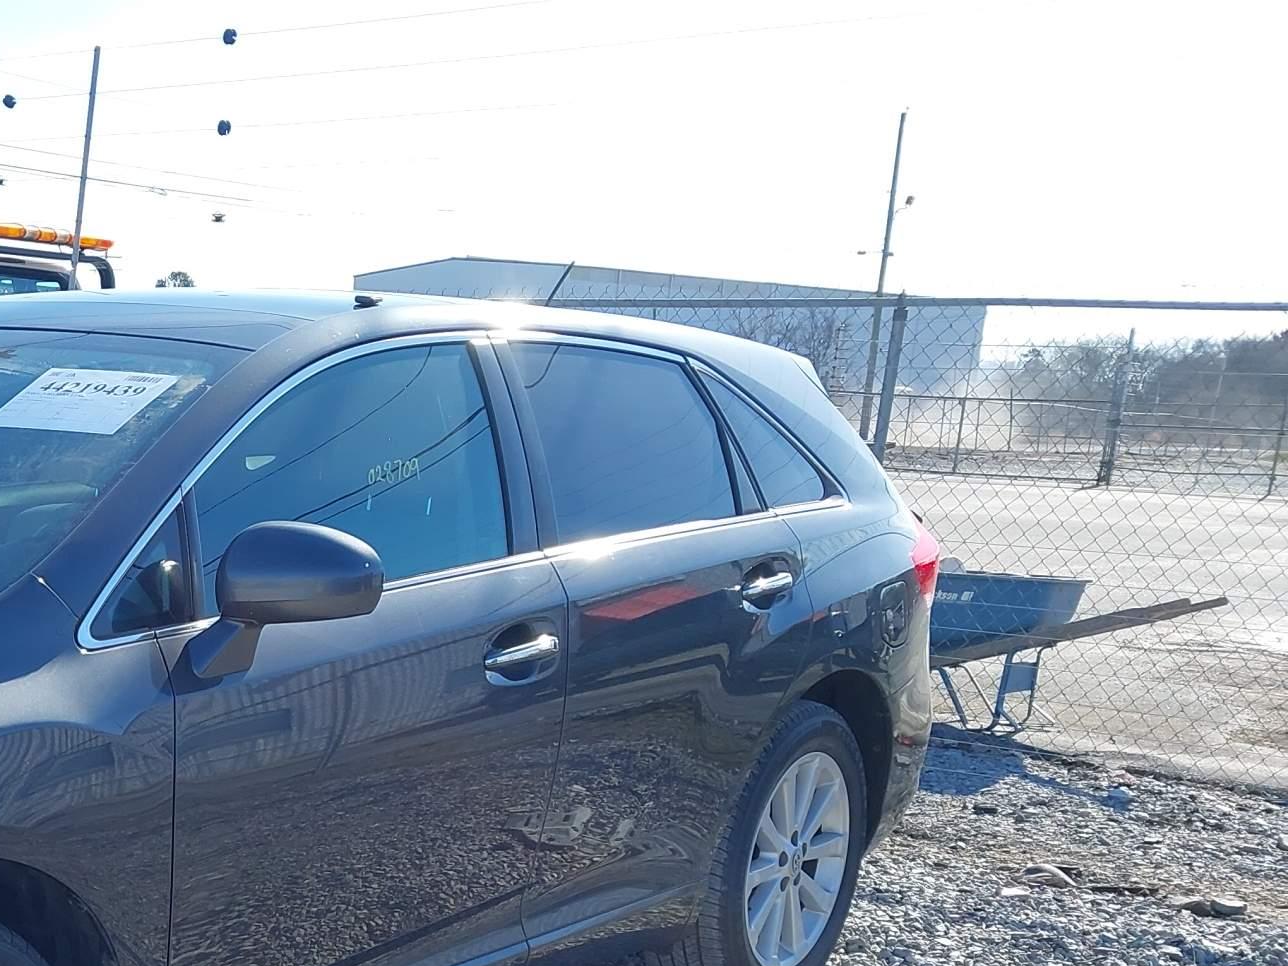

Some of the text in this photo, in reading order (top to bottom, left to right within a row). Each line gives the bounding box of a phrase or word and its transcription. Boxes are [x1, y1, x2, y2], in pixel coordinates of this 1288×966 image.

[40, 381, 147, 397] 44219439
[367, 457, 421, 484] 028709
[935, 589, 959, 601] kson
